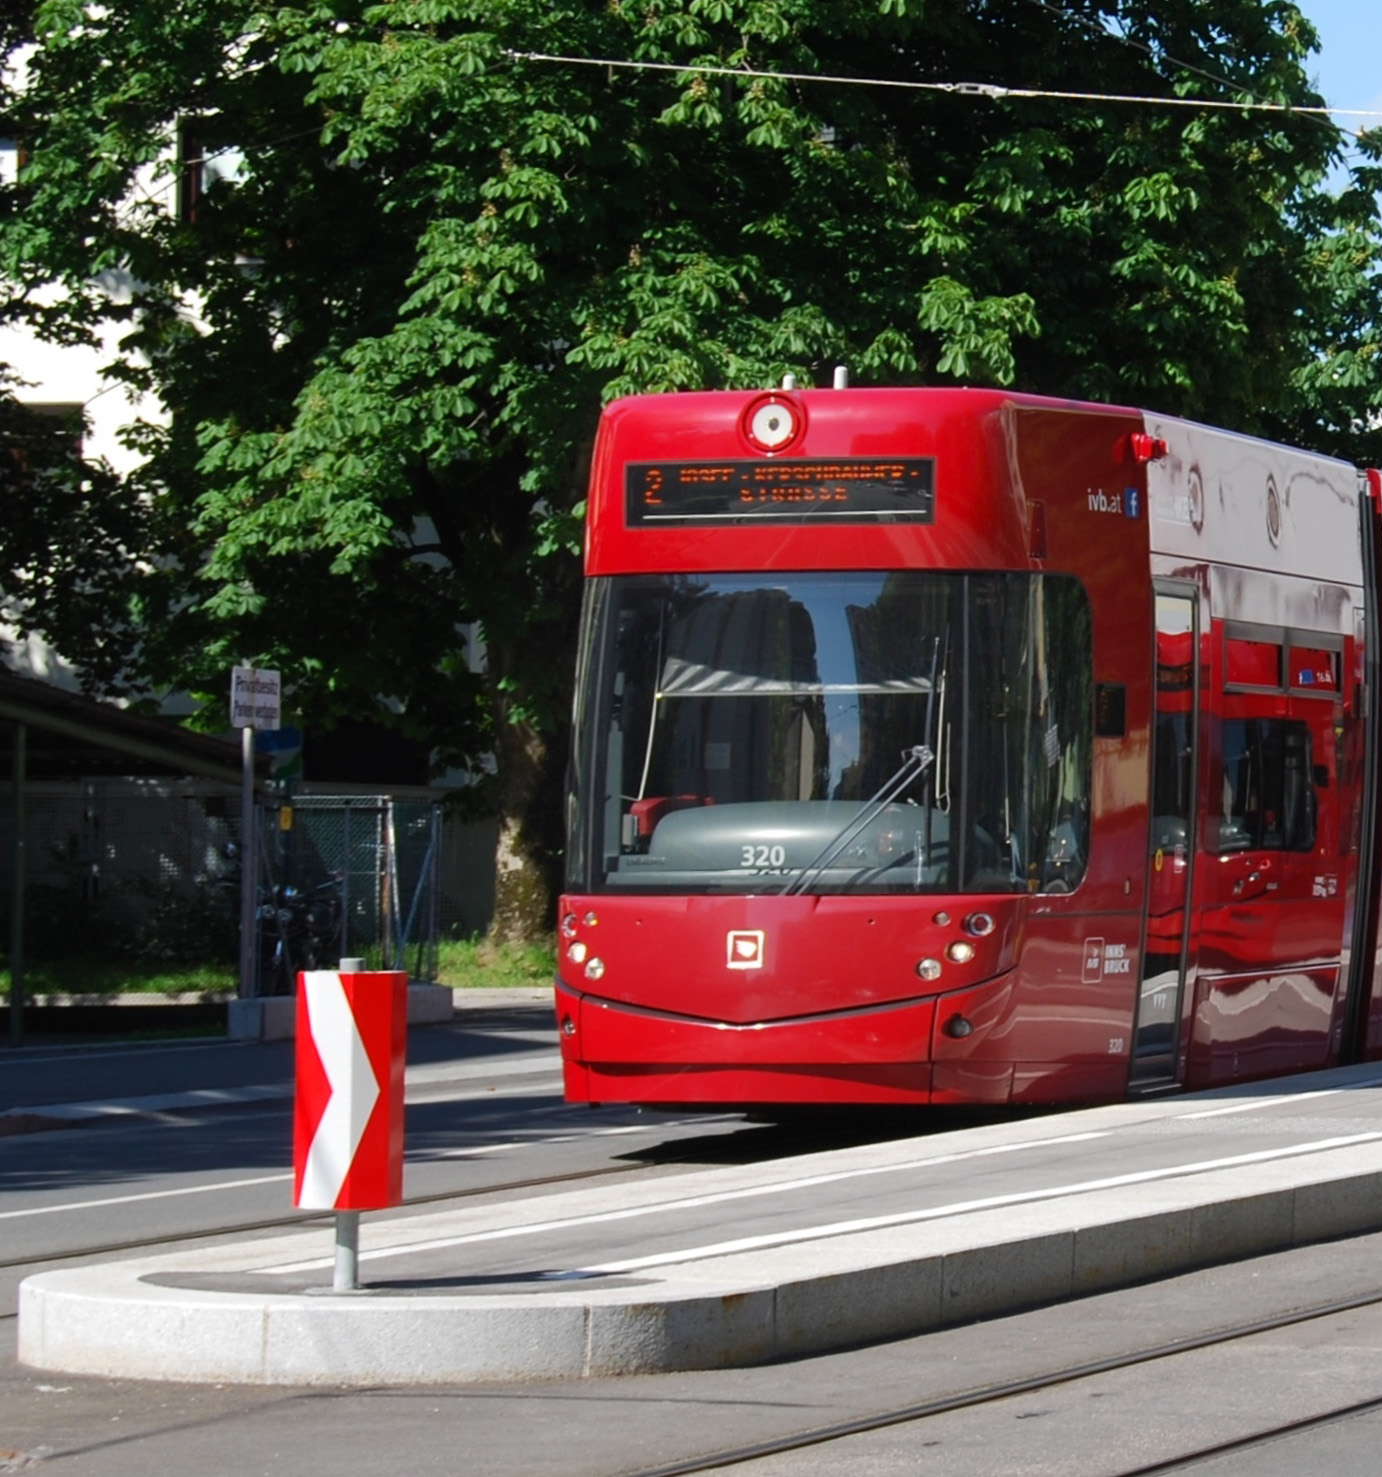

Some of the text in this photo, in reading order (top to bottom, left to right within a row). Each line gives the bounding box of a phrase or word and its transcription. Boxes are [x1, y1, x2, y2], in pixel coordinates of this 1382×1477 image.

[645, 468, 663, 504] 2
[1087, 488, 1122, 513] ivb.at
[741, 844, 786, 867] 320
[1108, 1037, 1124, 1055] 320
